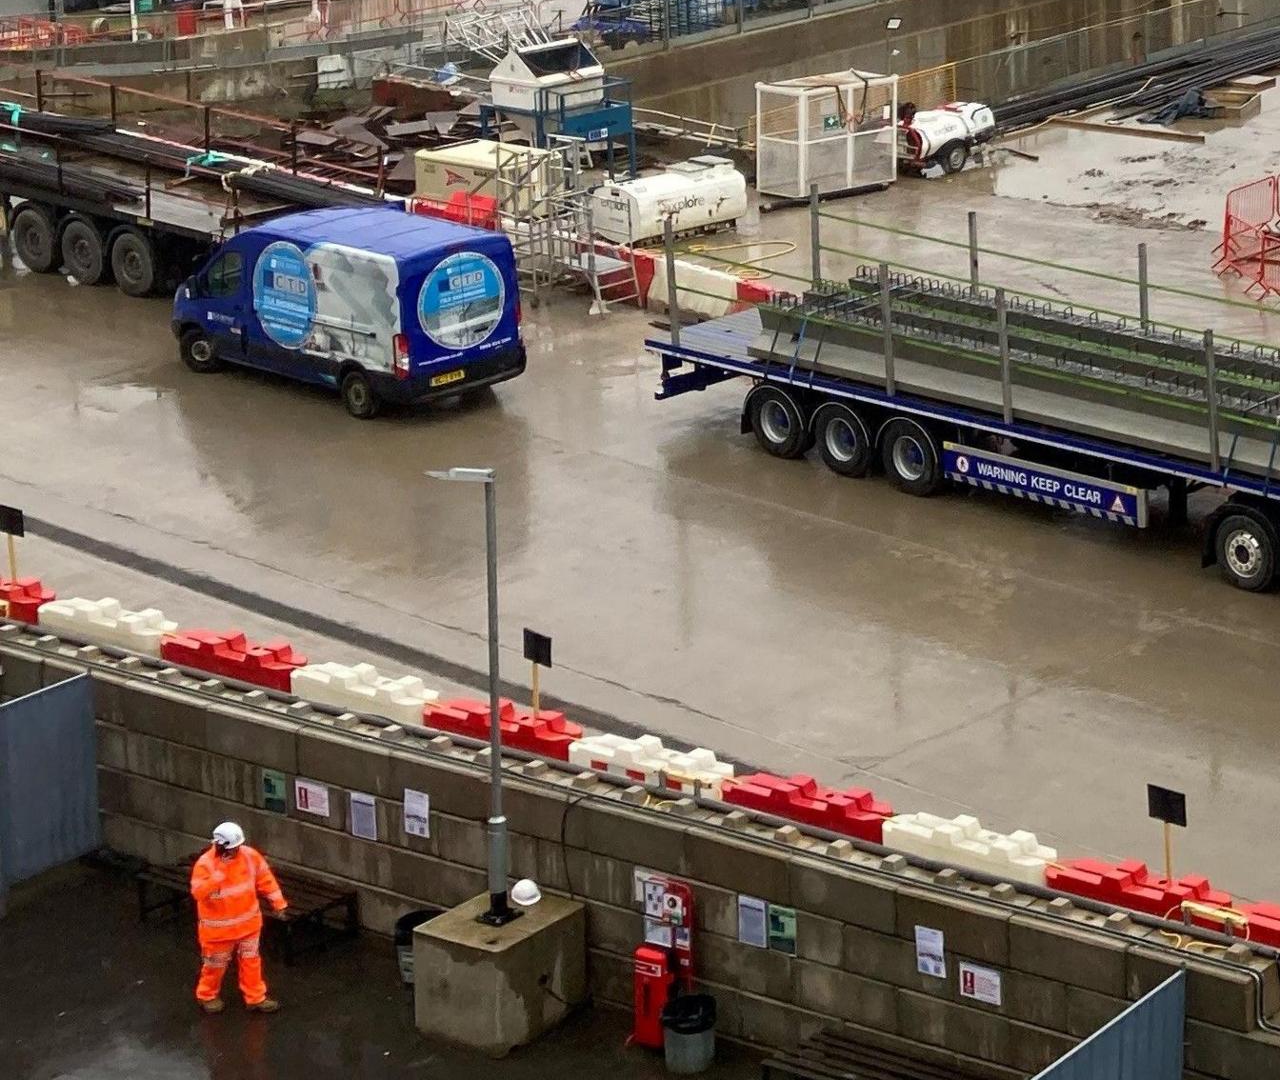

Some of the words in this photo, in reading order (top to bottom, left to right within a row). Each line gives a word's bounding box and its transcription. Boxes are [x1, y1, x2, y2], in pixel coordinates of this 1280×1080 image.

[275, 275, 307, 295] CTD
[452, 271, 483, 288] CTD
[976, 461, 1028, 486] WARNING
[1030, 475, 1061, 494] KEEP
[1064, 483, 1102, 505] CLEAR
